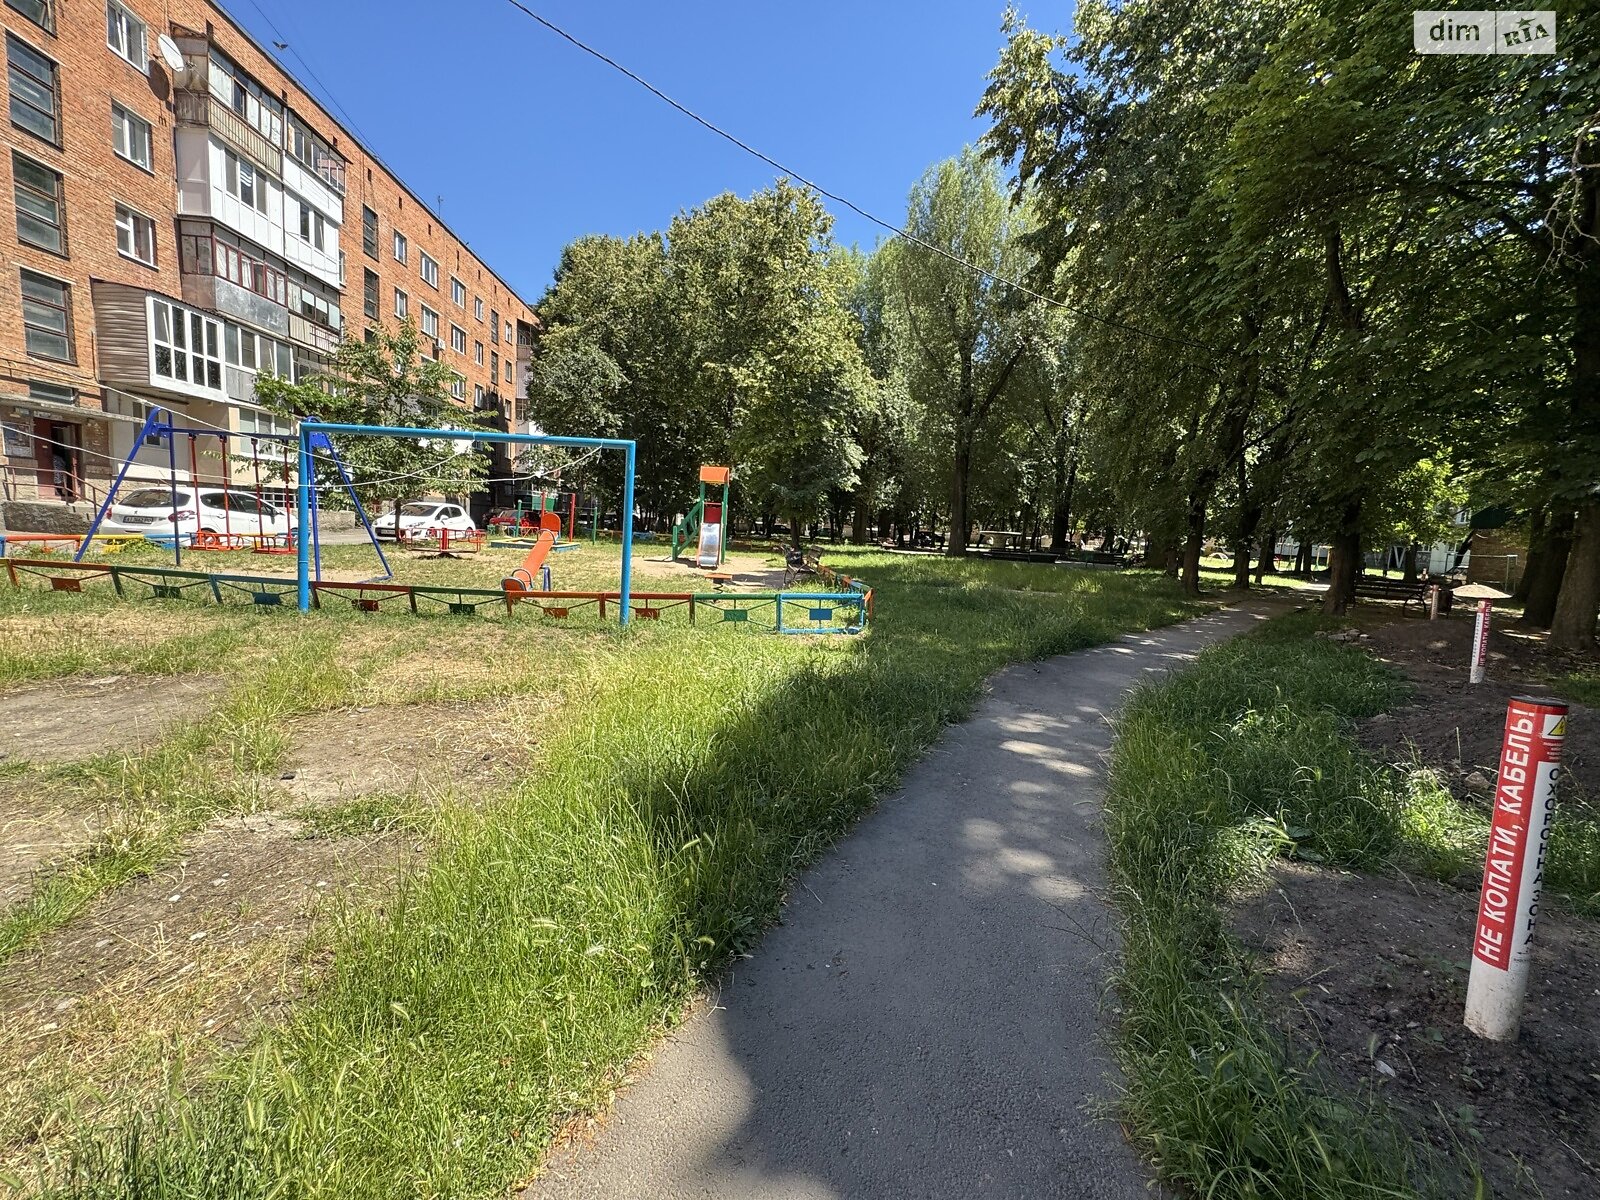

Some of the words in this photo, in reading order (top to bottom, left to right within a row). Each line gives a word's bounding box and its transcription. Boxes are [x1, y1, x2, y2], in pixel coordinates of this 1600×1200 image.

[1499, 708, 1535, 815] КАБЕЛЬ!
[1483, 822, 1523, 925] КОПАТИ,
[1478, 928, 1503, 962] НЕ
